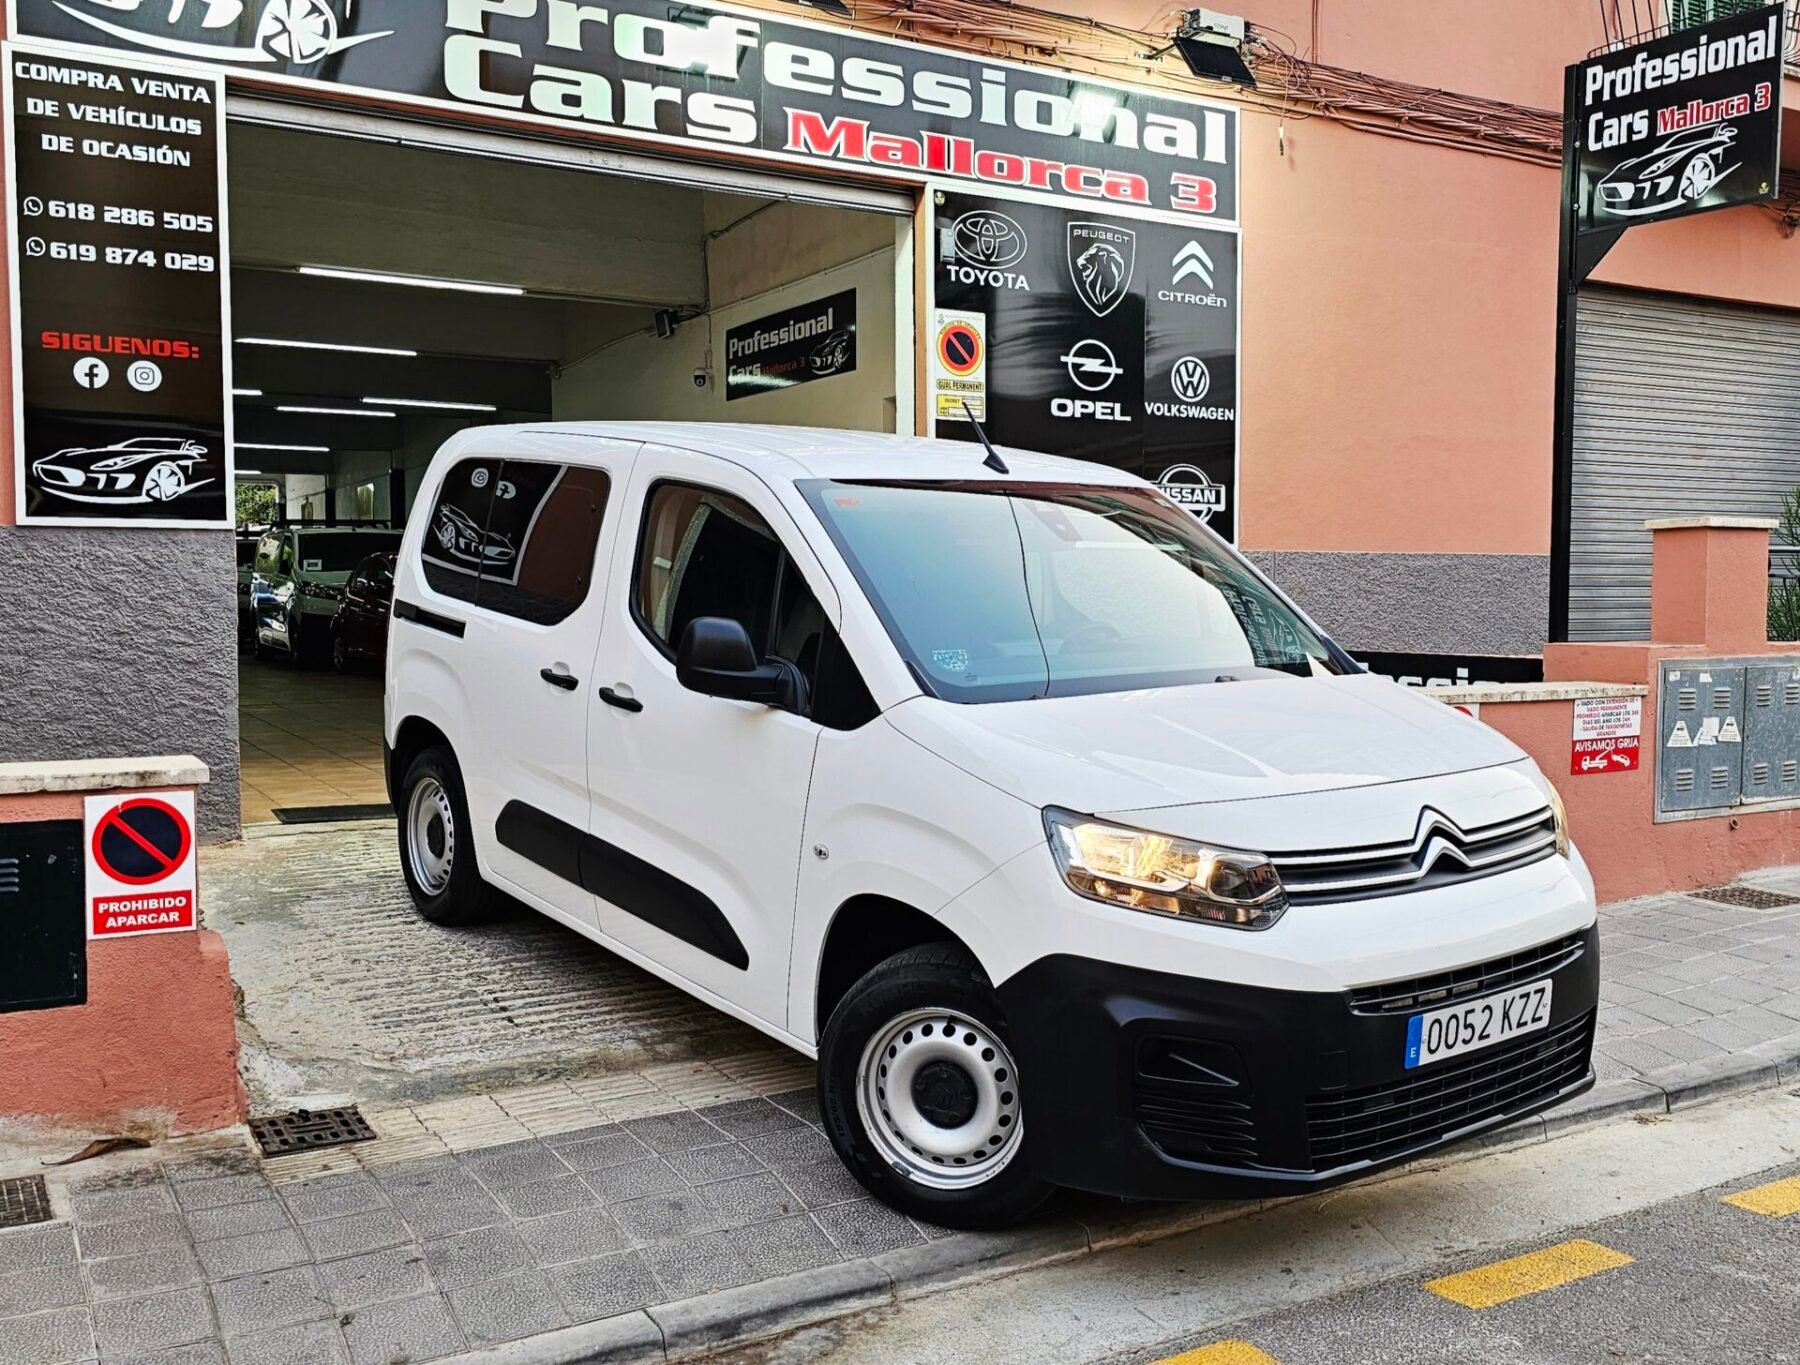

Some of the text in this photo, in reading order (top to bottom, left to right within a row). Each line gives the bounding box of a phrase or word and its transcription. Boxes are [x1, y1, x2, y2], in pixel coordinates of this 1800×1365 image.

[1585, 15, 1778, 106] Professional
[15, 62, 211, 104] COMPRA VENTA
[27, 98, 202, 136] DE VEHÍCULOS
[444, 34, 1217, 214] Cars Mallorca 3
[1588, 81, 1772, 151] Cars Mallorca 3
[41, 133, 191, 167] DE OCASIÓN
[48, 201, 213, 233] 618 286 505
[1073, 229, 1131, 245] PEUGEOT
[50, 242, 214, 273] 619 874 029
[947, 265, 1030, 291] TOYOTA
[41, 331, 199, 359] SIGUENOS:
[729, 307, 833, 360] Professional
[939, 380, 982, 391] GUAL PERMANENT
[1051, 398, 1131, 421] OPEL
[1144, 401, 1234, 421] VOLKSWAGEN
[1574, 737, 1639, 753] AVISAMOS GRUA
[98, 896, 187, 914] PROHIBIDO
[105, 911, 180, 928] APARCAR
[1410, 987, 1546, 1059] E 0052 KZZ
